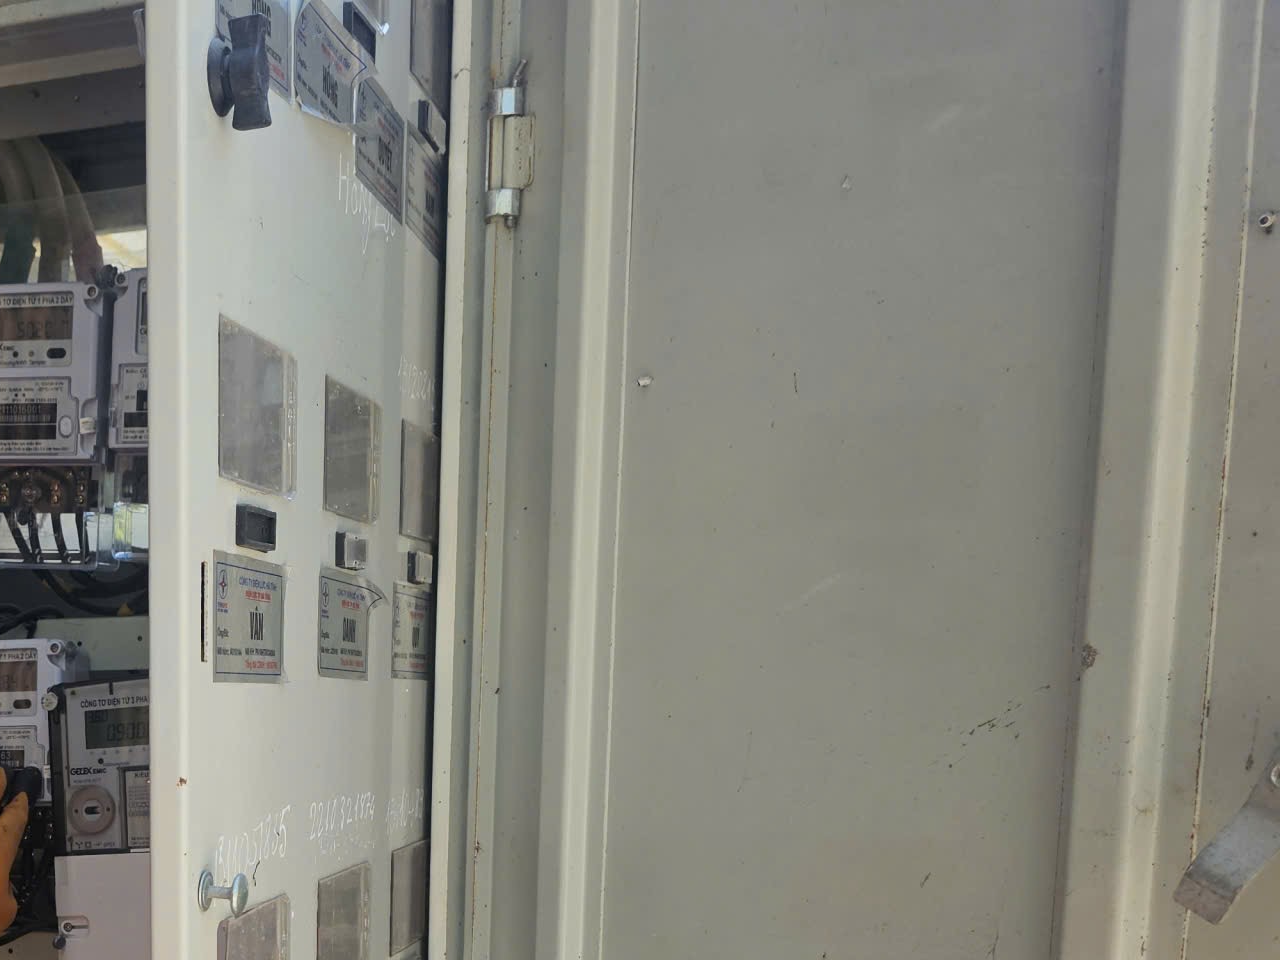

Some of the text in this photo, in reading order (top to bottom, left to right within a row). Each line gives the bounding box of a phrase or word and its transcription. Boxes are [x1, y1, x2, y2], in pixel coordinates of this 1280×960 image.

[42, 296, 54, 304] PHA
[249, 605, 264, 641] VÂN
[80, 698, 97, 708] CÔNG
[107, 696, 120, 706] ĐIỆN
[71, 767, 92, 776] GELEX
